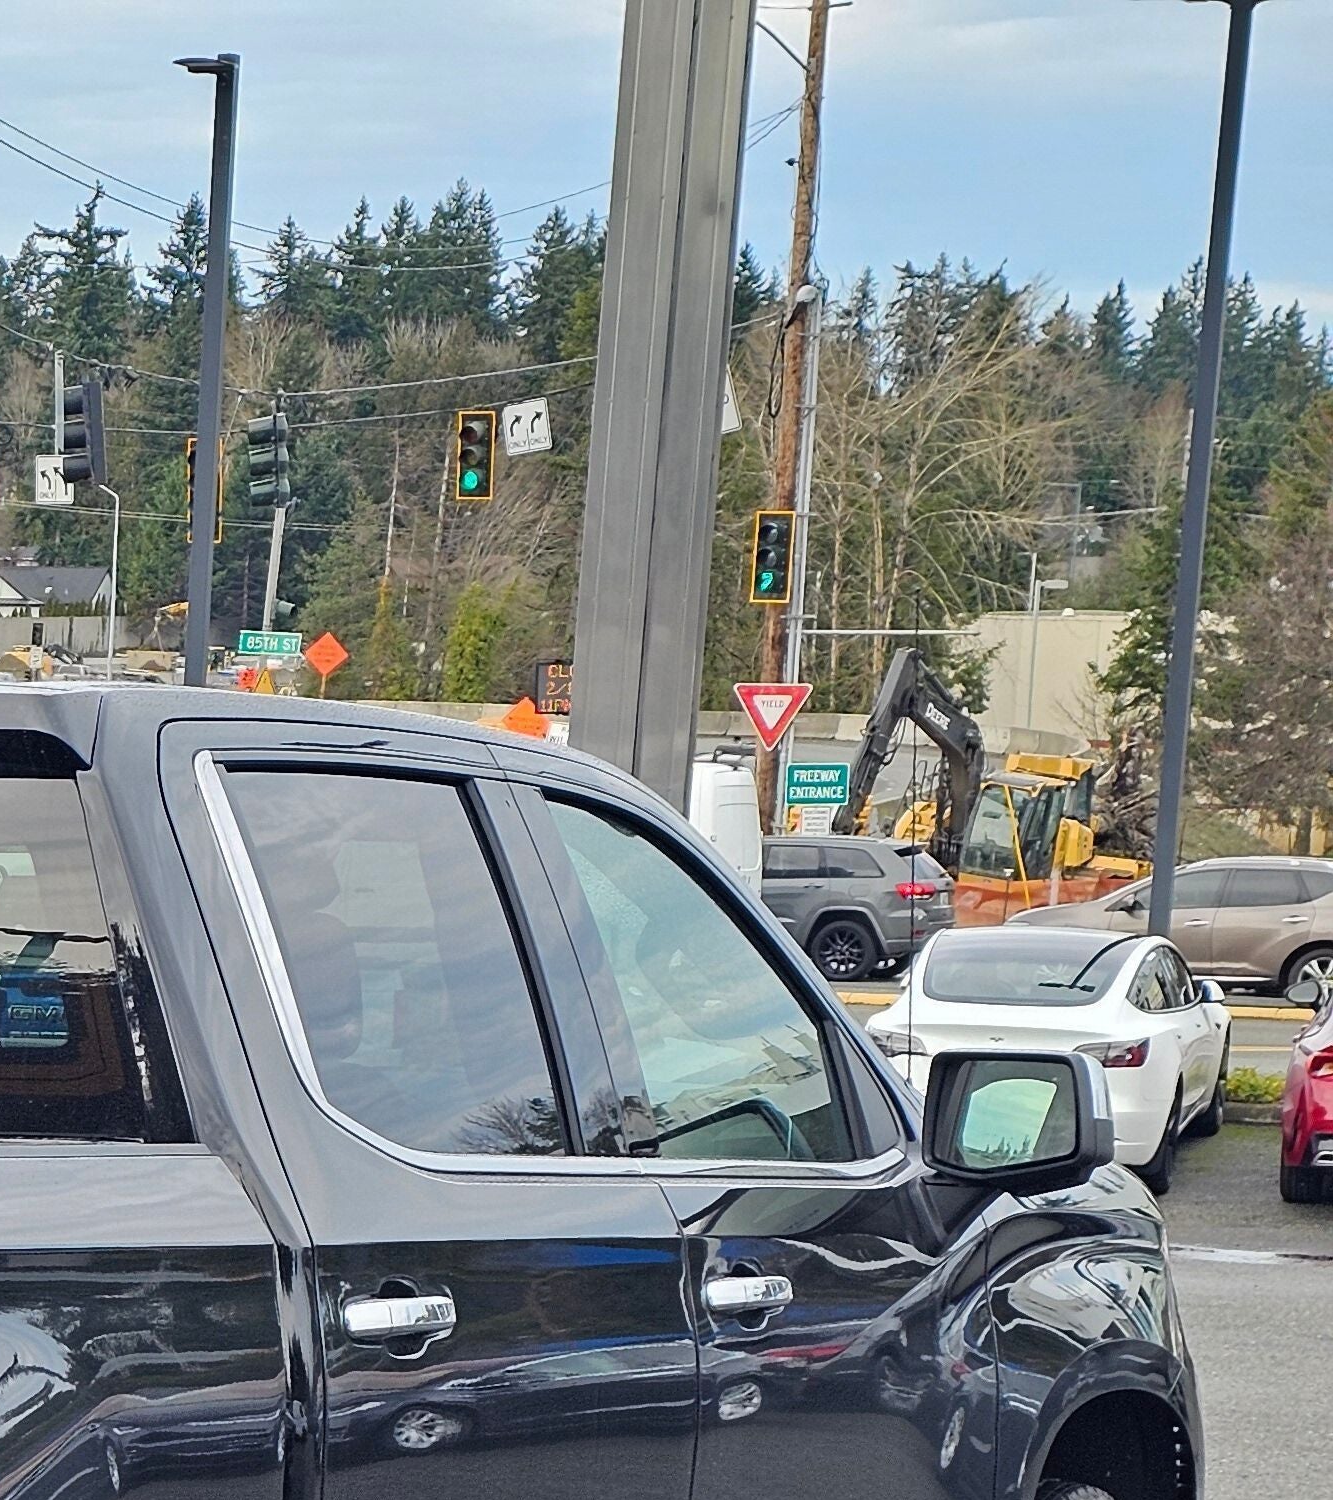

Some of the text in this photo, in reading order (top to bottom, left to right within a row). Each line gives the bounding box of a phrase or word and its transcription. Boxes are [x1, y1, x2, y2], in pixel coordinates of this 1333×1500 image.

[246, 636, 299, 652] 85TH ST
[761, 700, 784, 708] YIELD
[925, 702, 951, 731] DEERE
[793, 769, 841, 783] FREEWAY
[789, 785, 845, 799] ENTRANCE
